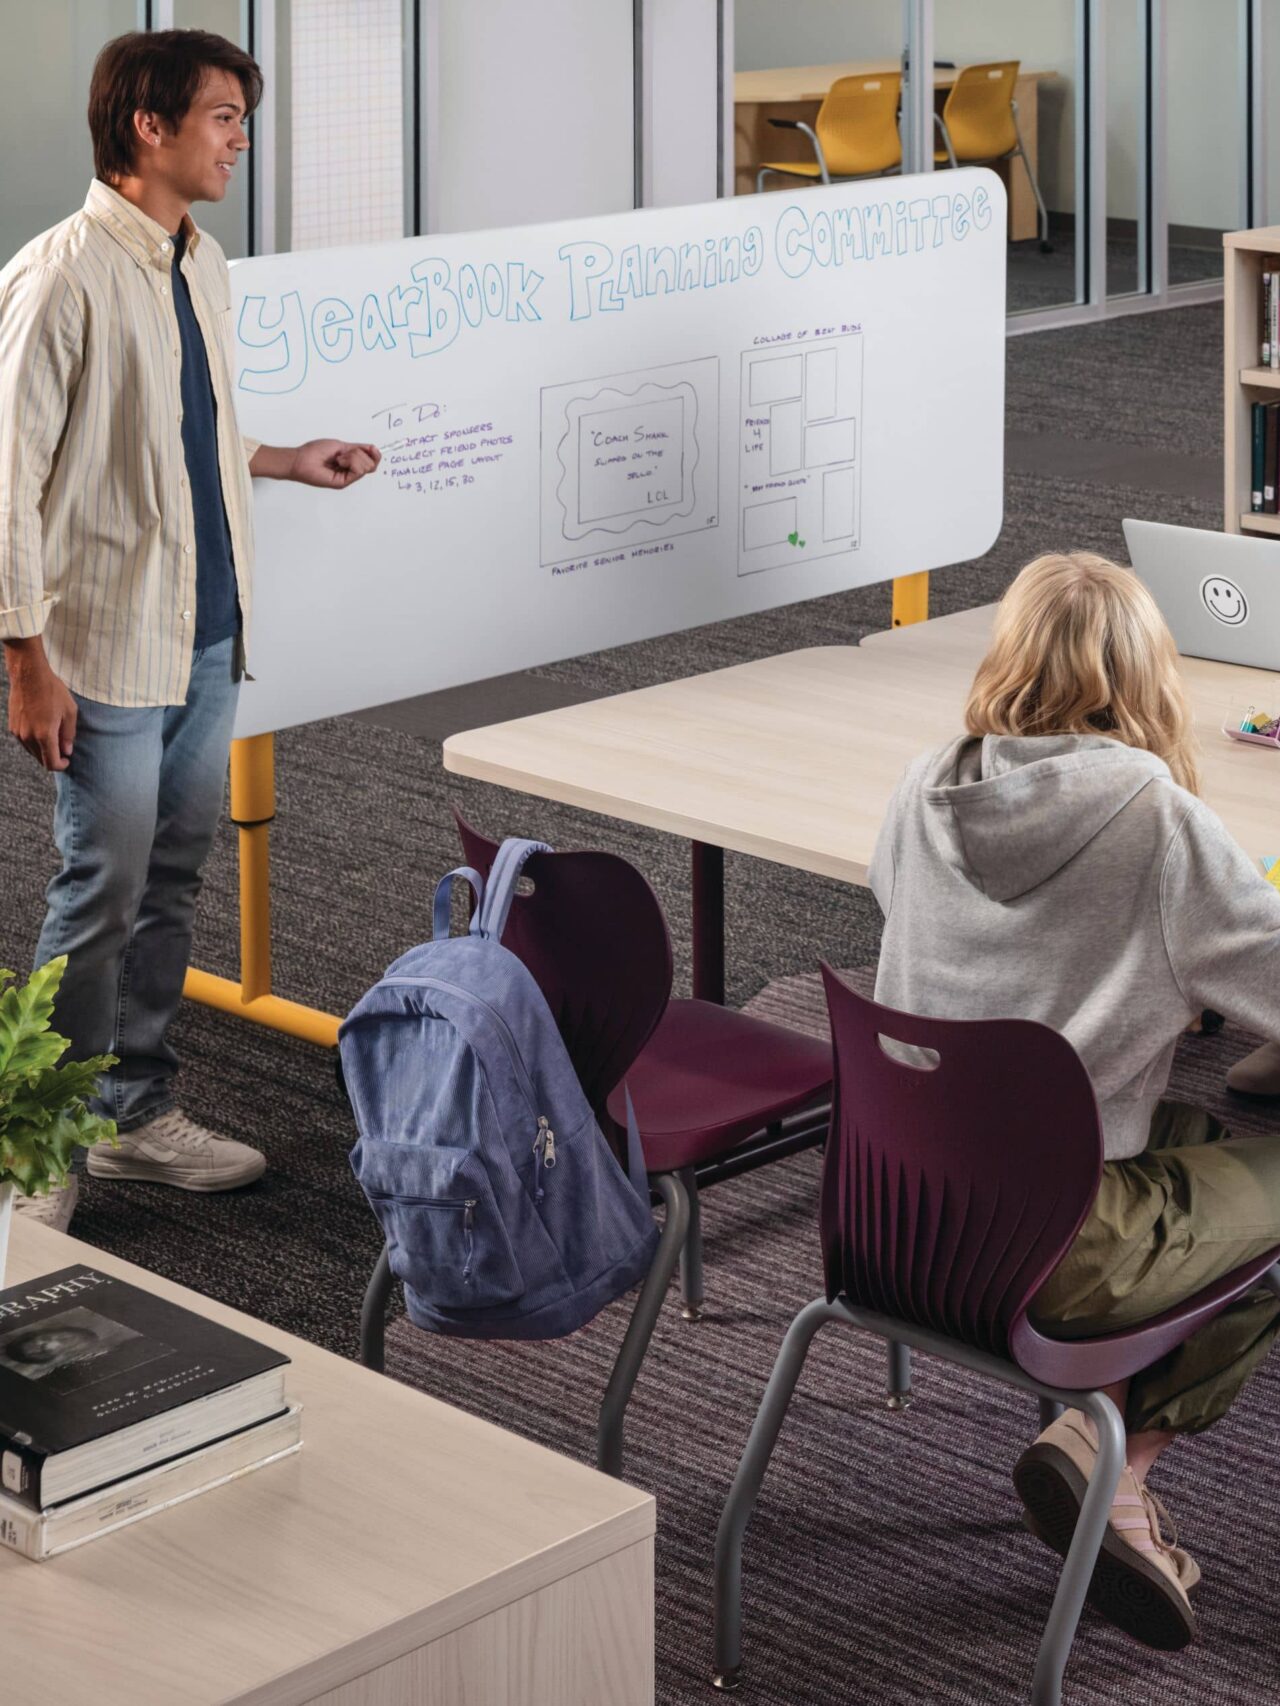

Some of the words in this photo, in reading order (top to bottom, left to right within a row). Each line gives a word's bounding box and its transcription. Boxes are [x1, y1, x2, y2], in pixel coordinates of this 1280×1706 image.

[371, 403, 407, 430] To
[390, 449, 435, 464] COLLECT
[441, 443, 477, 455] FRIEND
[480, 435, 513, 447] PHOTOS
[646, 450, 664, 458] THE
[745, 443, 763, 453] LIFE
[391, 463, 433, 477] FINALIZE
[438, 459, 464, 471] PAGE
[471, 453, 503, 465] LAYOUT
[551, 561, 588, 577] FAVORITE
[593, 554, 625, 567] SENIOR
[631, 543, 674, 558] MEMORIES
